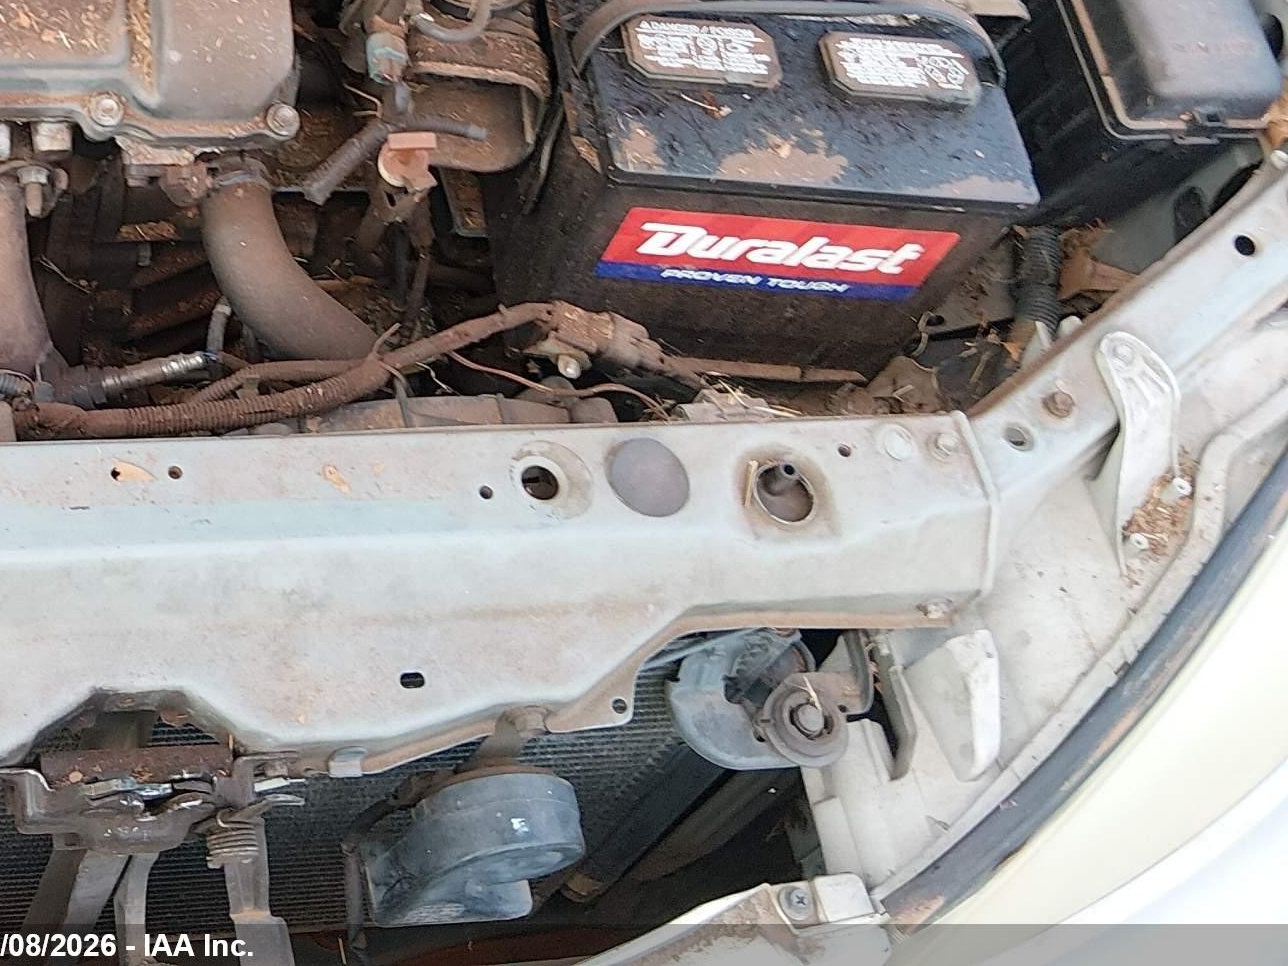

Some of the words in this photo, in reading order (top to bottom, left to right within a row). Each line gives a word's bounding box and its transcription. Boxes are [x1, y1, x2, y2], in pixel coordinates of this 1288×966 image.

[636, 222, 925, 274] Duralast
[660, 269, 761, 285] PROVEN
[766, 277, 850, 293] TOUGH
